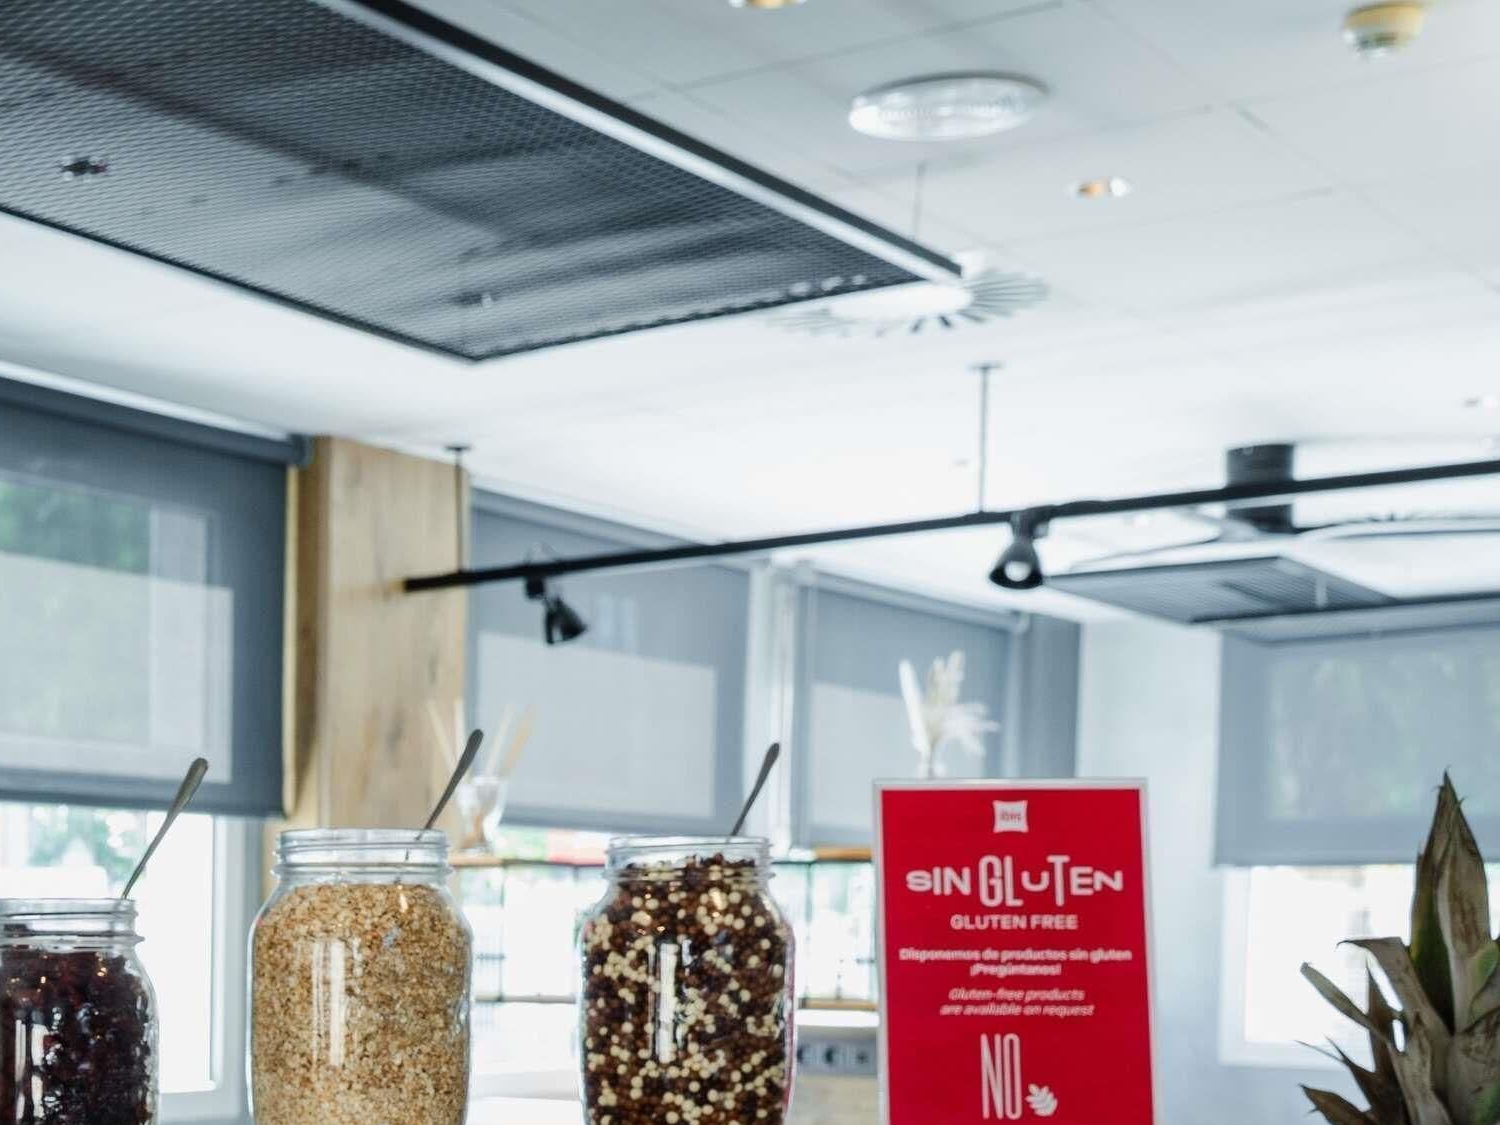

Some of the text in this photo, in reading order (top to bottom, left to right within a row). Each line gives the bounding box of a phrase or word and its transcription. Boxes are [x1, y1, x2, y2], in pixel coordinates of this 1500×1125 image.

[906, 855, 1123, 907] SIN GLUTEN
[950, 914, 1078, 930] GLUTEN FREE
[982, 947, 998, 960] de
[1001, 948, 1067, 963] productos
[1069, 948, 1088, 961] sin
[1090, 948, 1132, 963] gluten
[1025, 988, 1084, 1003] products
[940, 1005, 961, 1016] are
[963, 1004, 1021, 1016] available
[1043, 1005, 1094, 1018] request
[980, 1033, 1022, 1120] NO
